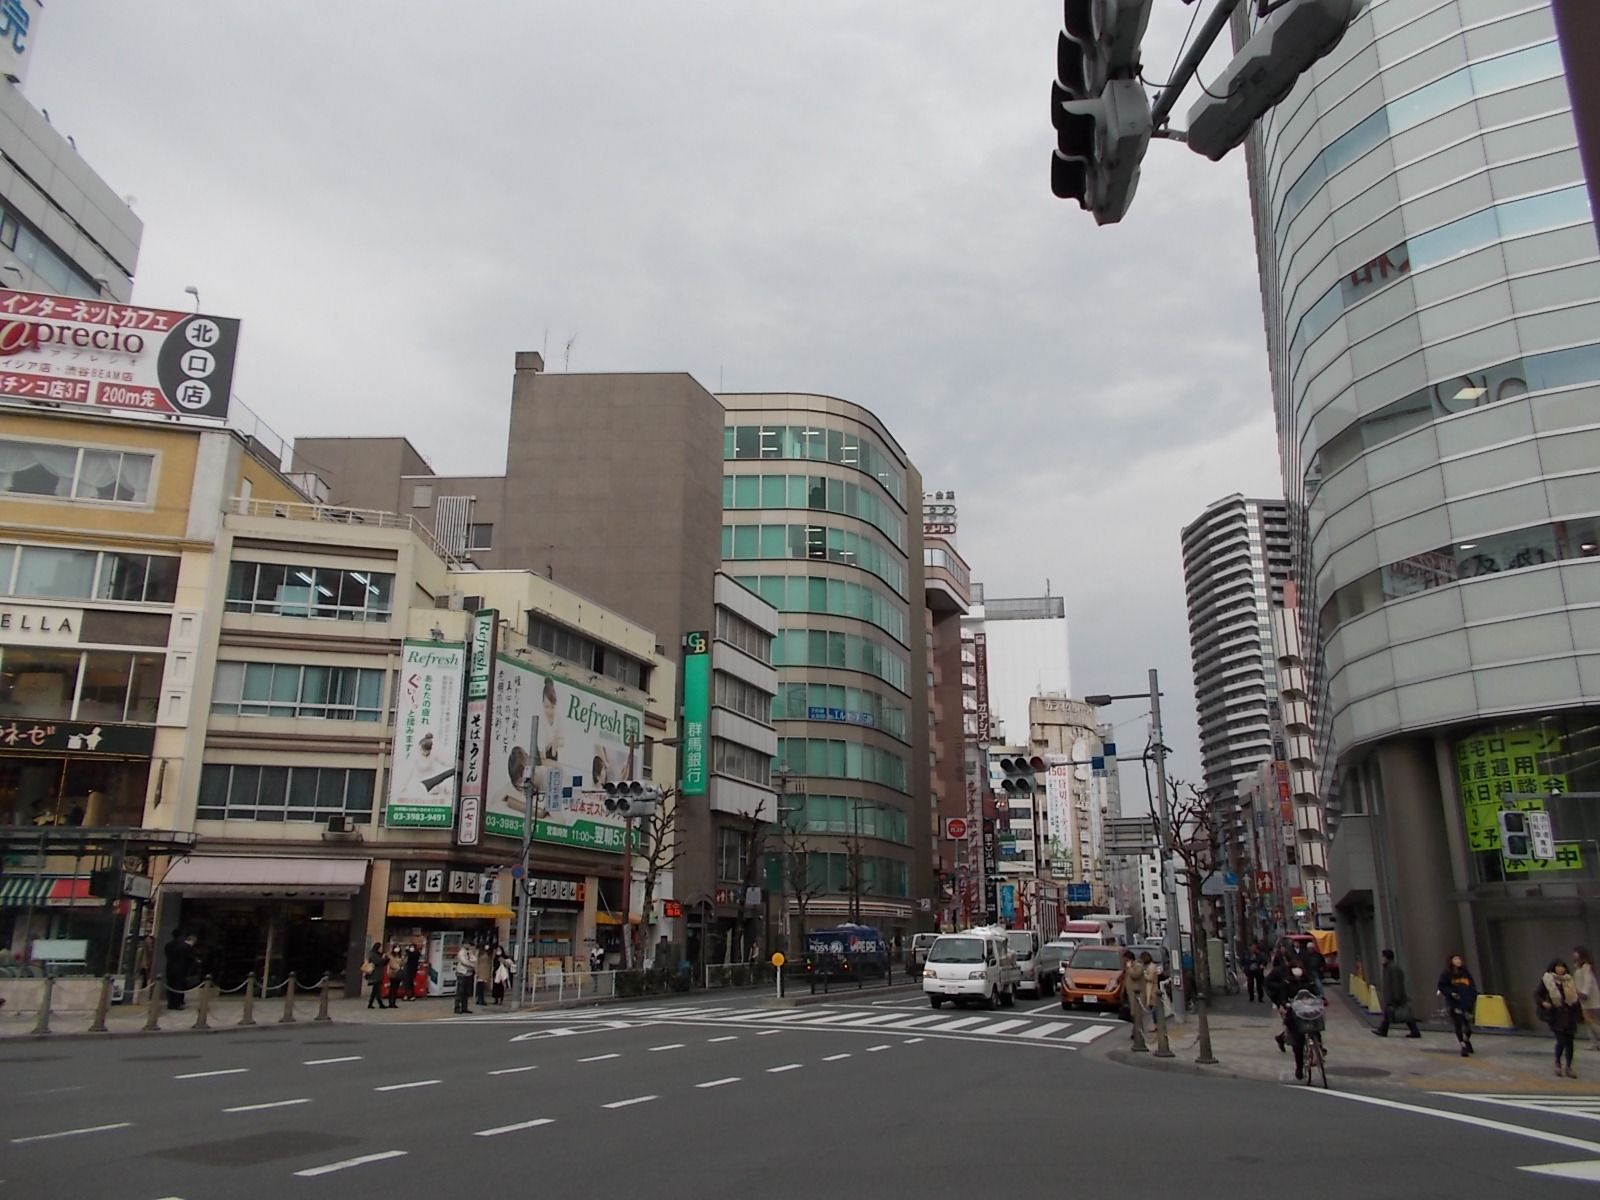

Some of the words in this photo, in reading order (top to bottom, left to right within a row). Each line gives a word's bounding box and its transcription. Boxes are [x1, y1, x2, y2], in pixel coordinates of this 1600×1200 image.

[4, 295, 169, 330] インターネットカフェ
[182, 324, 213, 404] 北口店
[102, 386, 156, 407] 200m先
[475, 621, 490, 671] Refresh
[688, 632, 706, 653] GB
[407, 650, 459, 668] Refresh
[567, 694, 622, 735] Refresh
[978, 703, 989, 741] オアシス
[0, 722, 56, 746] ネーゼ
[1458, 733, 1556, 760] 住宅ローン
[466, 713, 481, 783] そばうどん
[687, 721, 702, 783] 群馬銀行
[1460, 755, 1535, 781] 資産運用
[485, 815, 540, 833] 03-3983-91
[407, 872, 441, 889] そば
